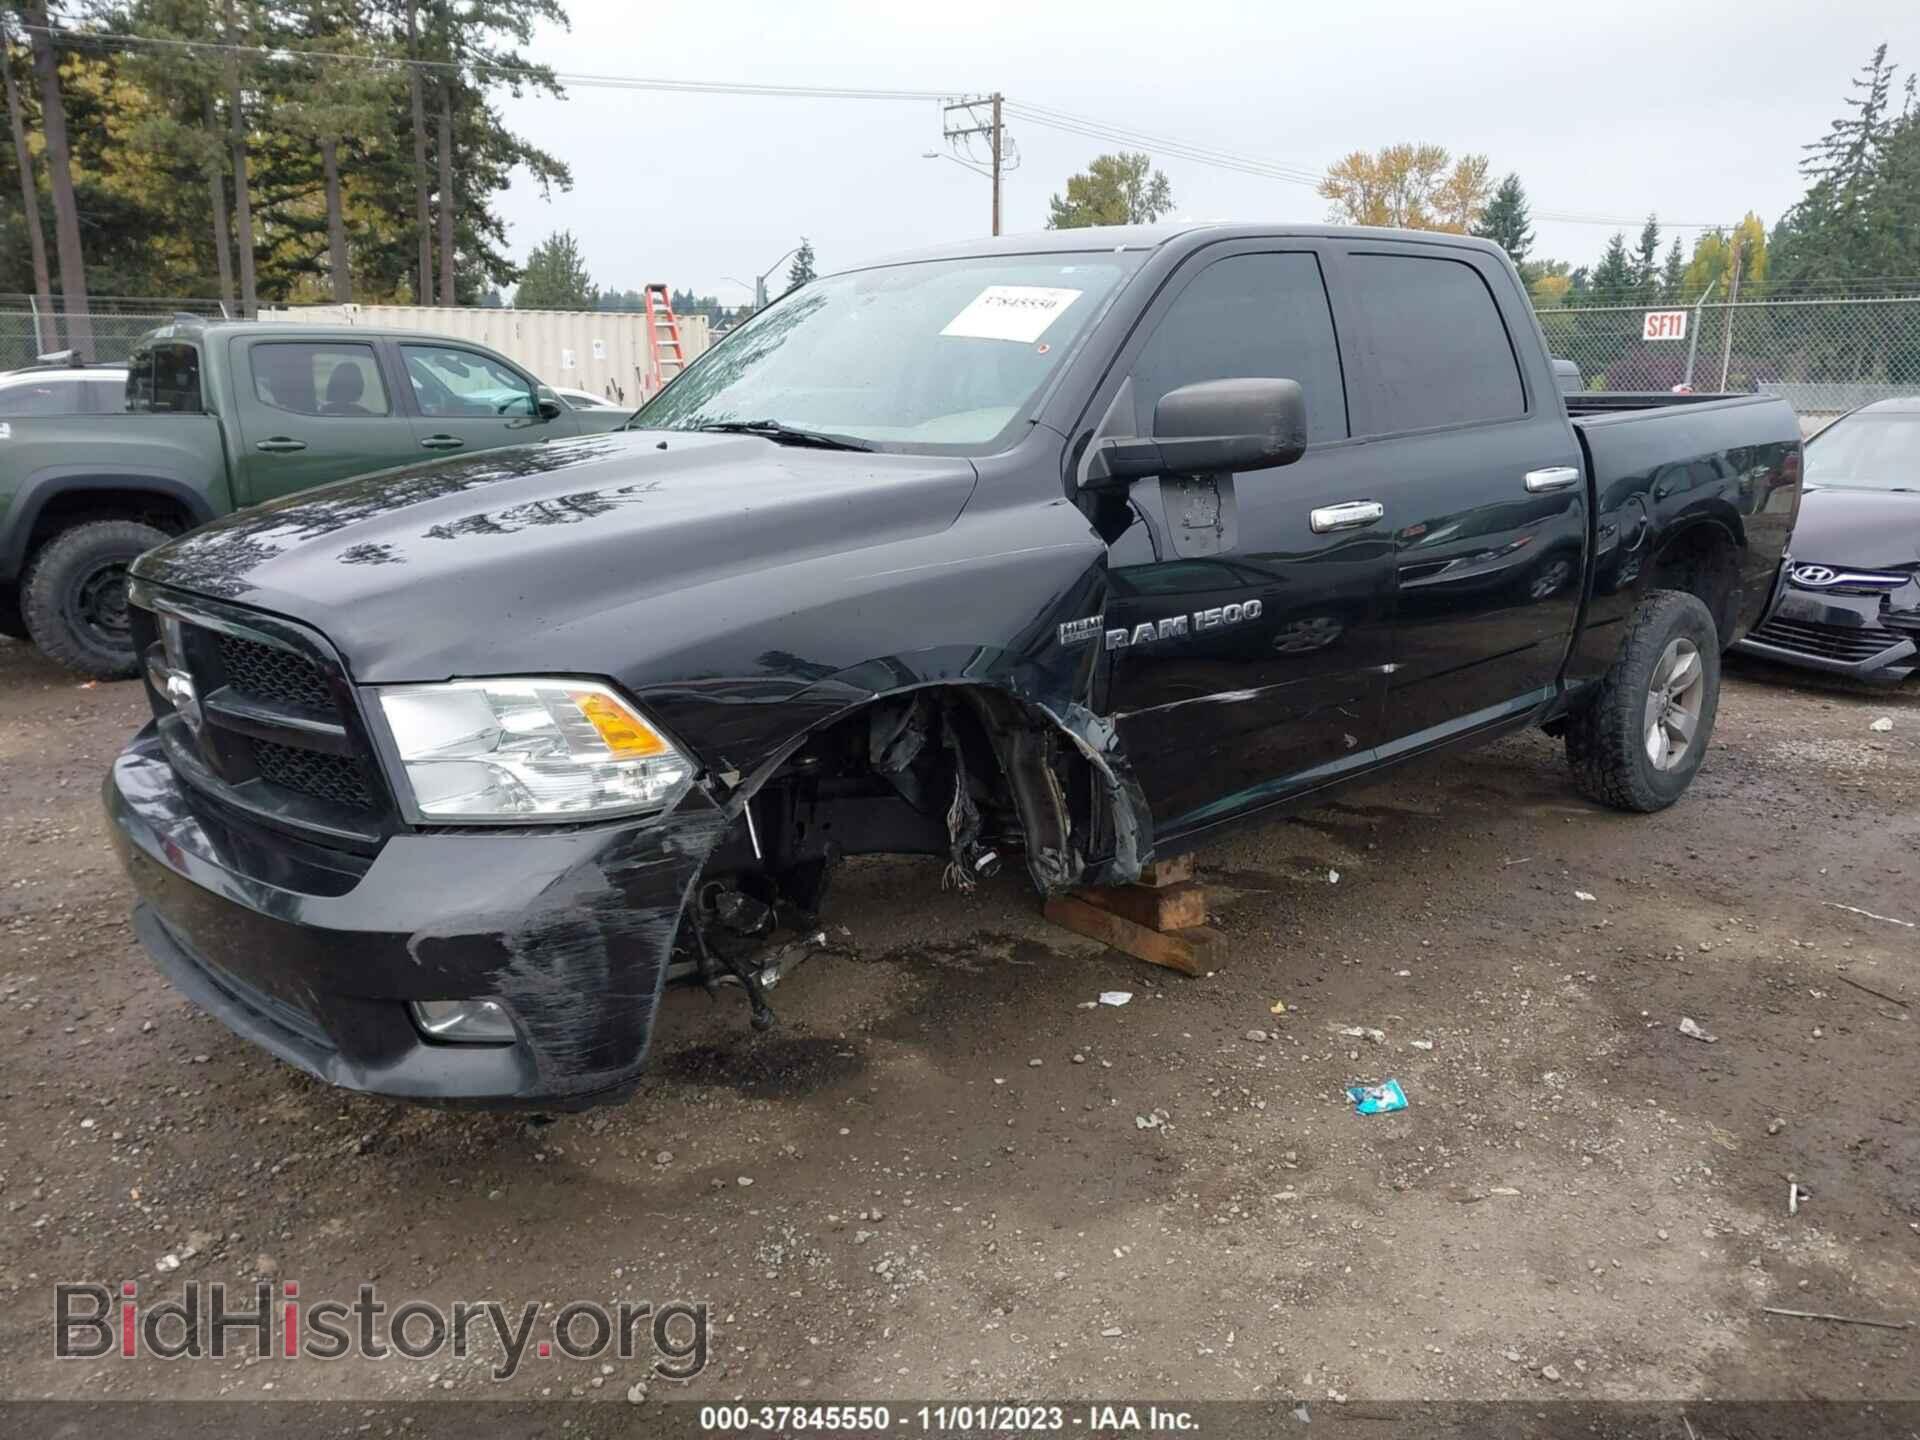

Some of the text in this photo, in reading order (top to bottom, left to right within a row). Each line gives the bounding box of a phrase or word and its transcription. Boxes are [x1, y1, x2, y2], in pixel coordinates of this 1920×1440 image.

[1647, 314, 1683, 337] SF11
[1105, 615, 1188, 650] RAM
[1193, 599, 1263, 631] 1500
